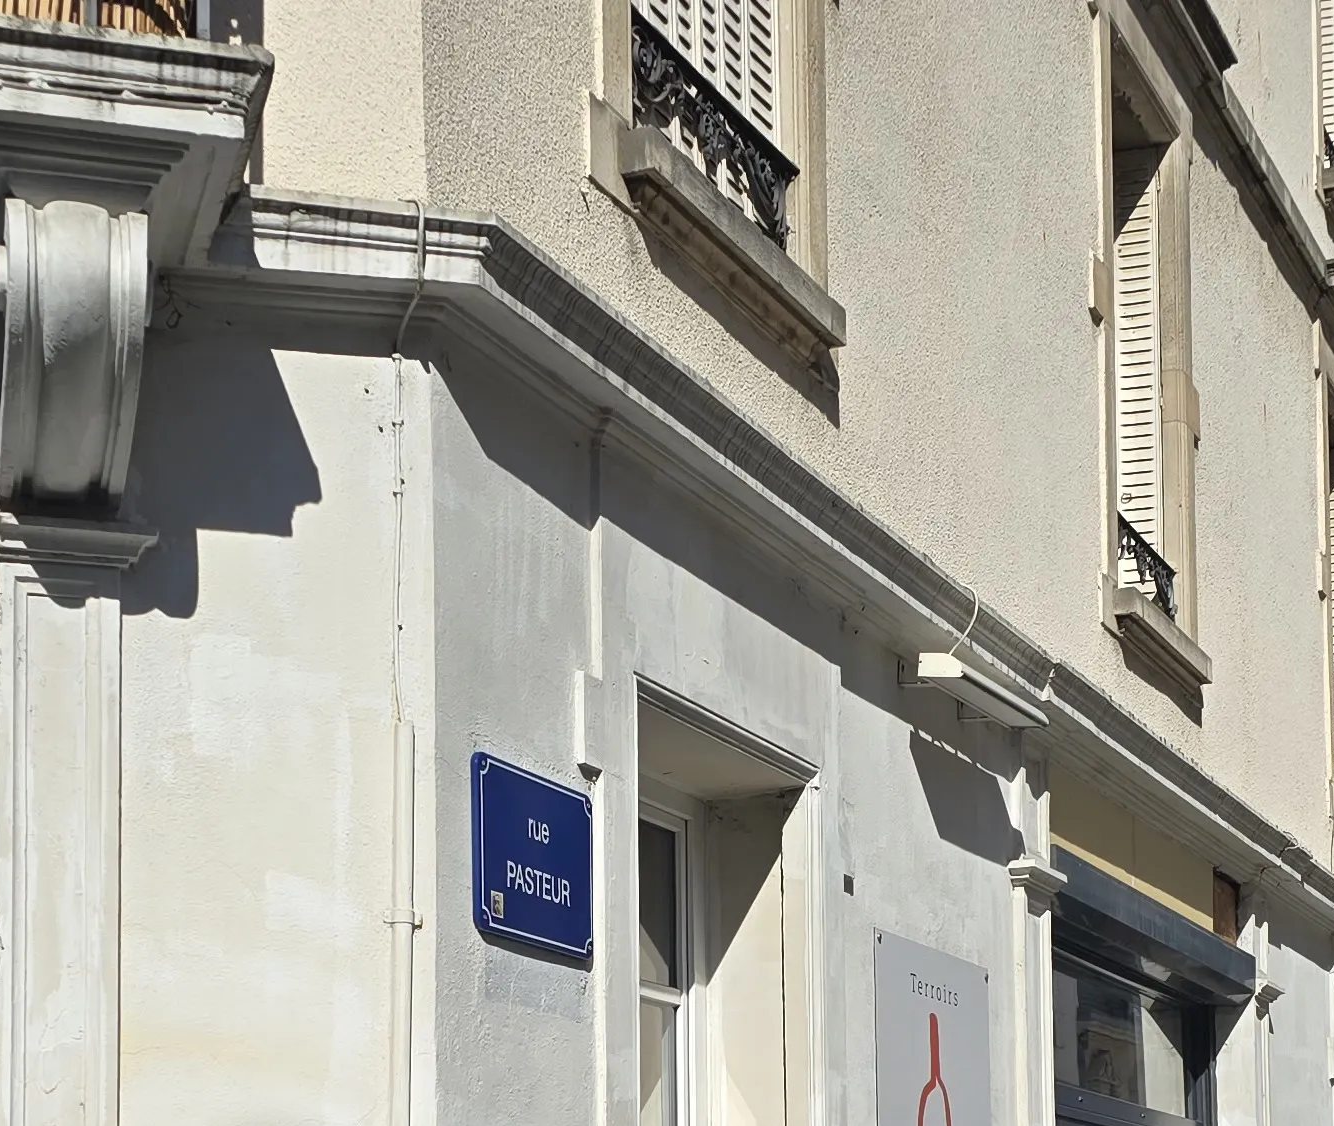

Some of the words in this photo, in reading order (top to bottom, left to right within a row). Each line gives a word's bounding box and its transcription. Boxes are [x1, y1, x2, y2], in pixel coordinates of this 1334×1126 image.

[527, 817, 550, 845] rue
[506, 859, 571, 908] PASTEUR
[910, 972, 958, 1007] Terroirs
